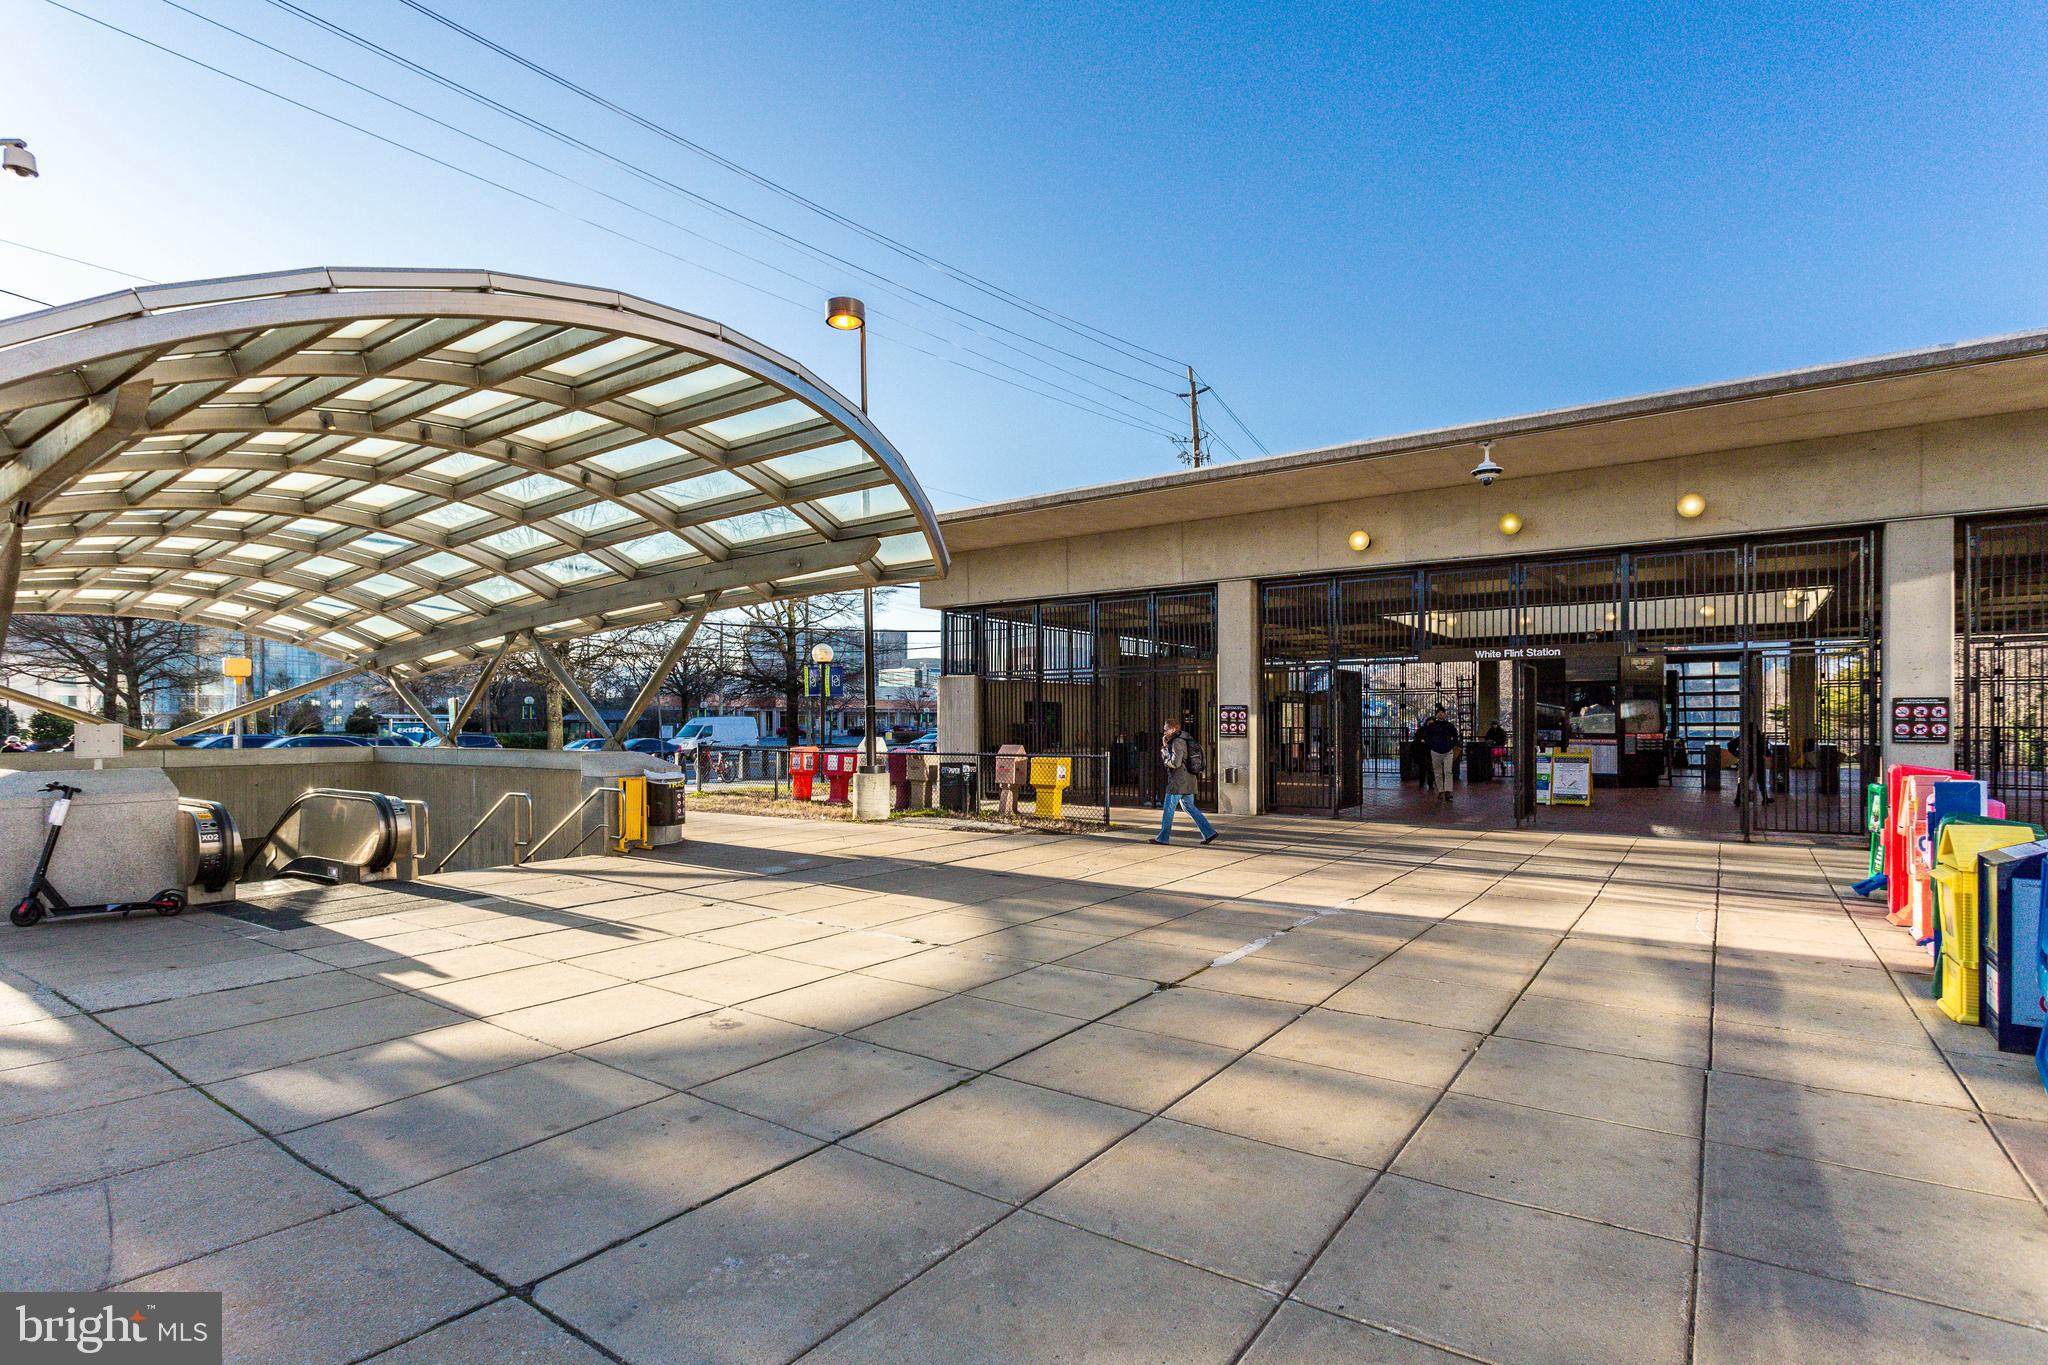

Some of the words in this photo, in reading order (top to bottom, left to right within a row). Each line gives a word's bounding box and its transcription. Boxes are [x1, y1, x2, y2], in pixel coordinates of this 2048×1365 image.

[1475, 649, 1501, 659] White
[1504, 649, 1523, 658] Flint
[1526, 647, 1561, 657] Station
